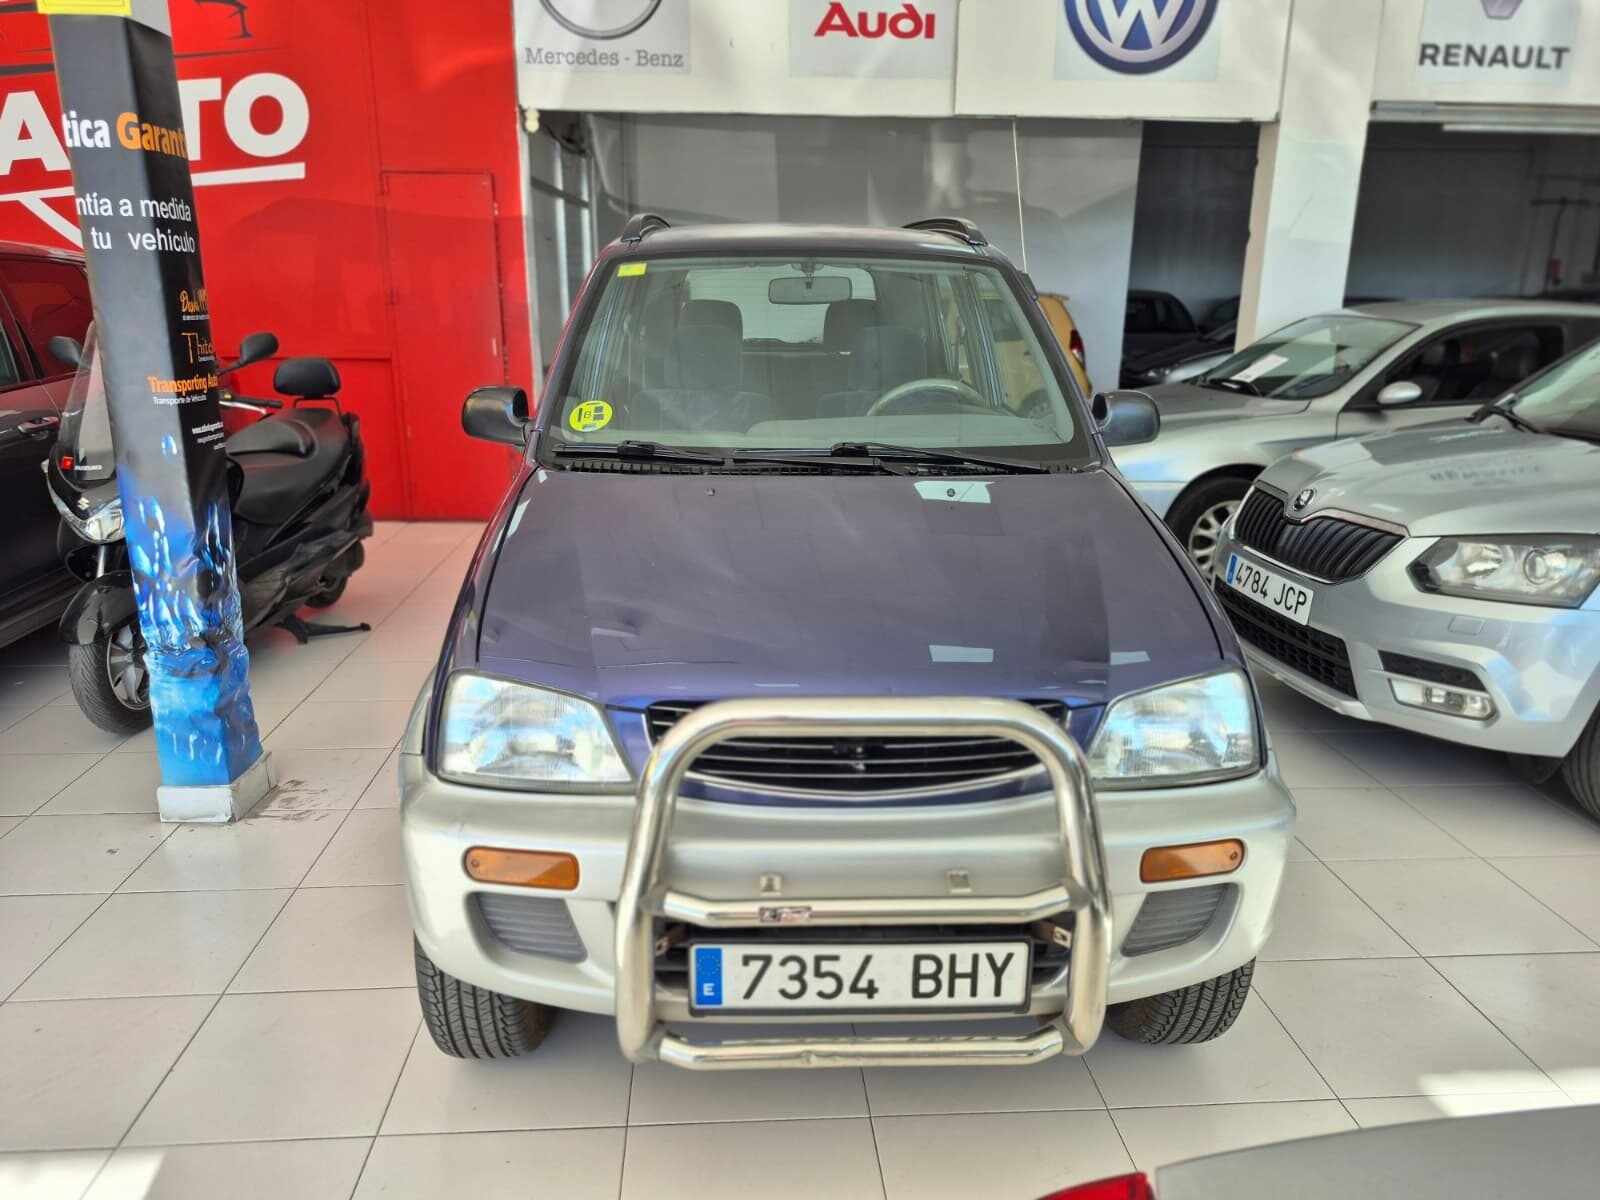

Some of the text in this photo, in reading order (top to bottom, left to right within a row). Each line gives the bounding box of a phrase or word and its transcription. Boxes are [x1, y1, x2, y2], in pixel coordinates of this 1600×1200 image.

[814, 2, 935, 39] Audi
[525, 47, 619, 65] Mercedes
[635, 49, 684, 67] Benz
[1418, 43, 1571, 69] RENAULT
[119, 198, 133, 217] a
[140, 197, 192, 222] medida
[91, 226, 112, 249] tu
[147, 374, 208, 396] Transporting
[1235, 562, 1308, 615] 4784 JCP
[703, 952, 1015, 1000] E 7354 BHY
